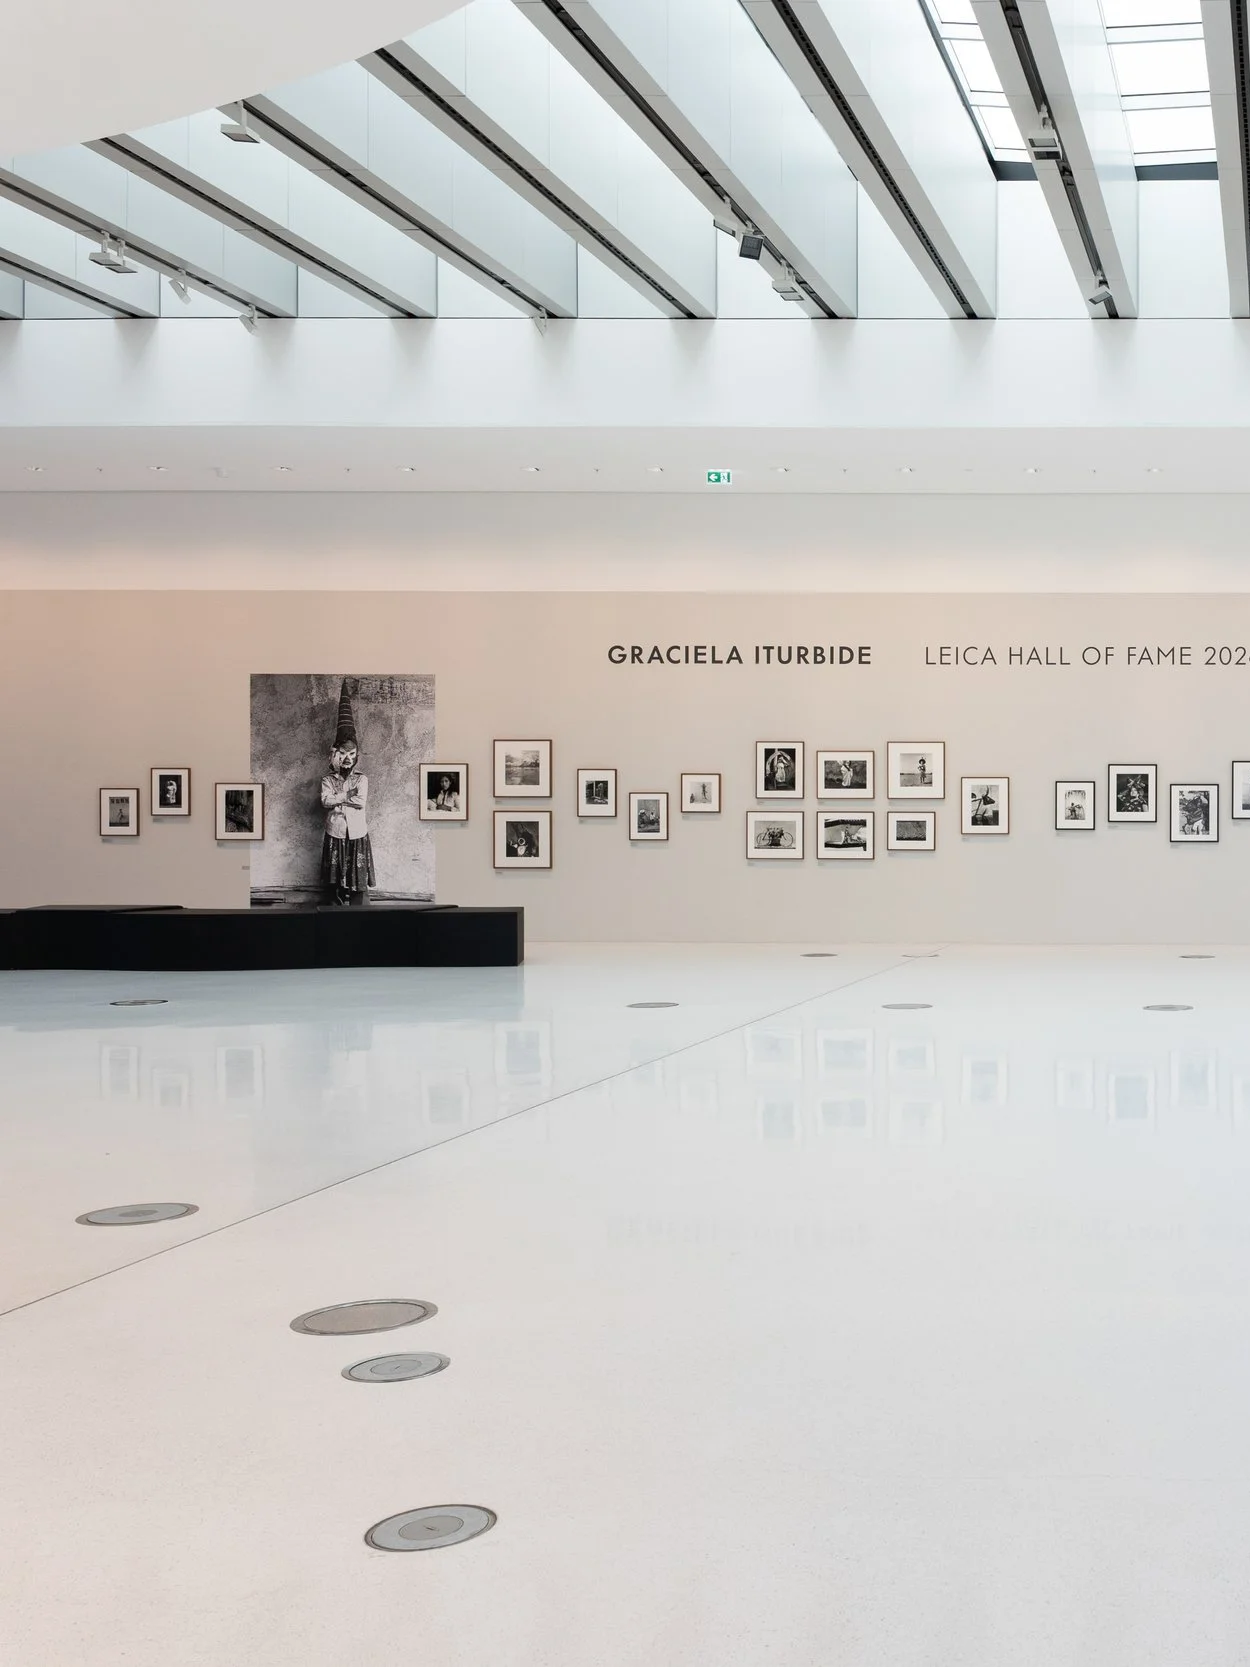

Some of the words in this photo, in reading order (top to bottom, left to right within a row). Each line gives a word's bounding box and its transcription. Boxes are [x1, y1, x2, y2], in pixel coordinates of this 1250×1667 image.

[607, 644, 744, 665] GRACIELA
[754, 645, 872, 665] ITURBIDE
[925, 646, 997, 666] LEICA
[1008, 646, 1071, 666] HALL
[1081, 646, 1115, 666] OF
[1127, 646, 1192, 666] FAME
